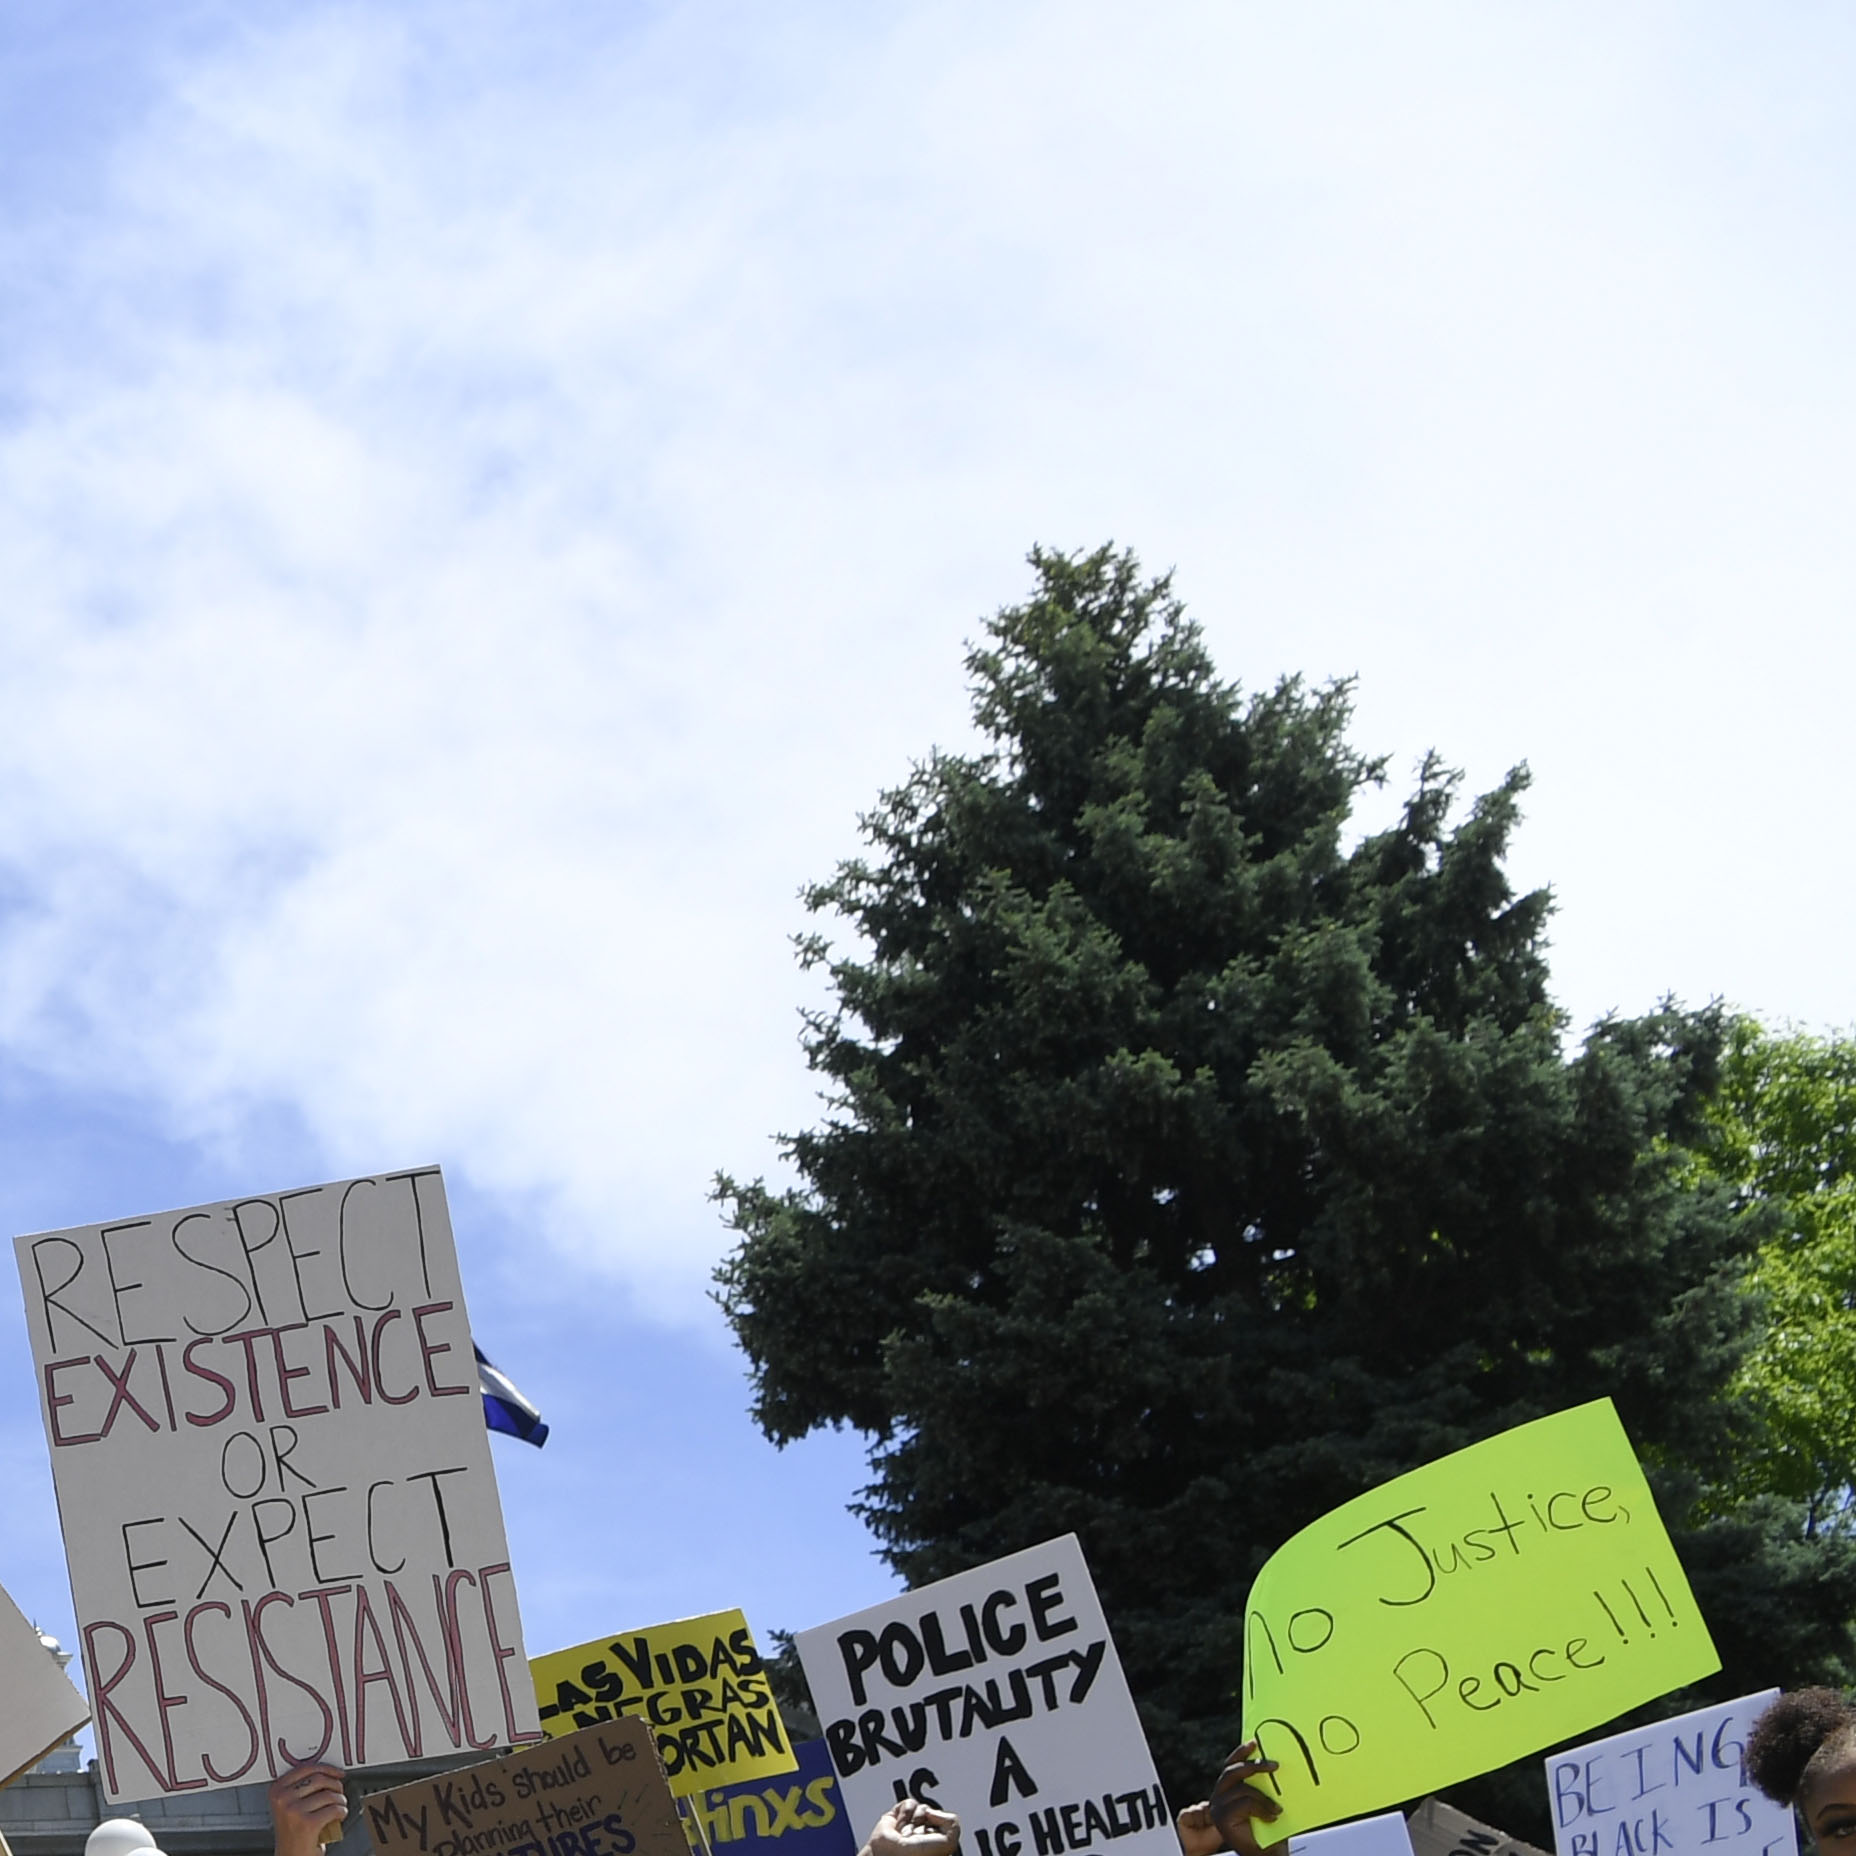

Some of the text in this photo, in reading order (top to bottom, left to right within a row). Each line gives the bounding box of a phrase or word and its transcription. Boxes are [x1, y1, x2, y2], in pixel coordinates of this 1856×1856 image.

[31, 1171, 441, 1354] RESPECT
[44, 1302, 471, 1447] EXISTENCE
[220, 1425, 317, 1499] OR
[122, 1467, 468, 1608] EXPECT
[83, 1561, 543, 1795] RESISTANCE
[609, 1628, 765, 1690] VIDAS
[837, 1572, 1079, 1706] POLICE
[825, 1639, 1106, 1778] BRUTALITY
[369, 1738, 637, 1851] My Kids should be
[535, 1794, 601, 1841] their
[988, 1735, 1039, 1808] A
[1029, 1783, 1167, 1856] HEALTH
[1555, 1717, 1747, 1828] BEING
[1697, 1797, 1752, 1845] IS
